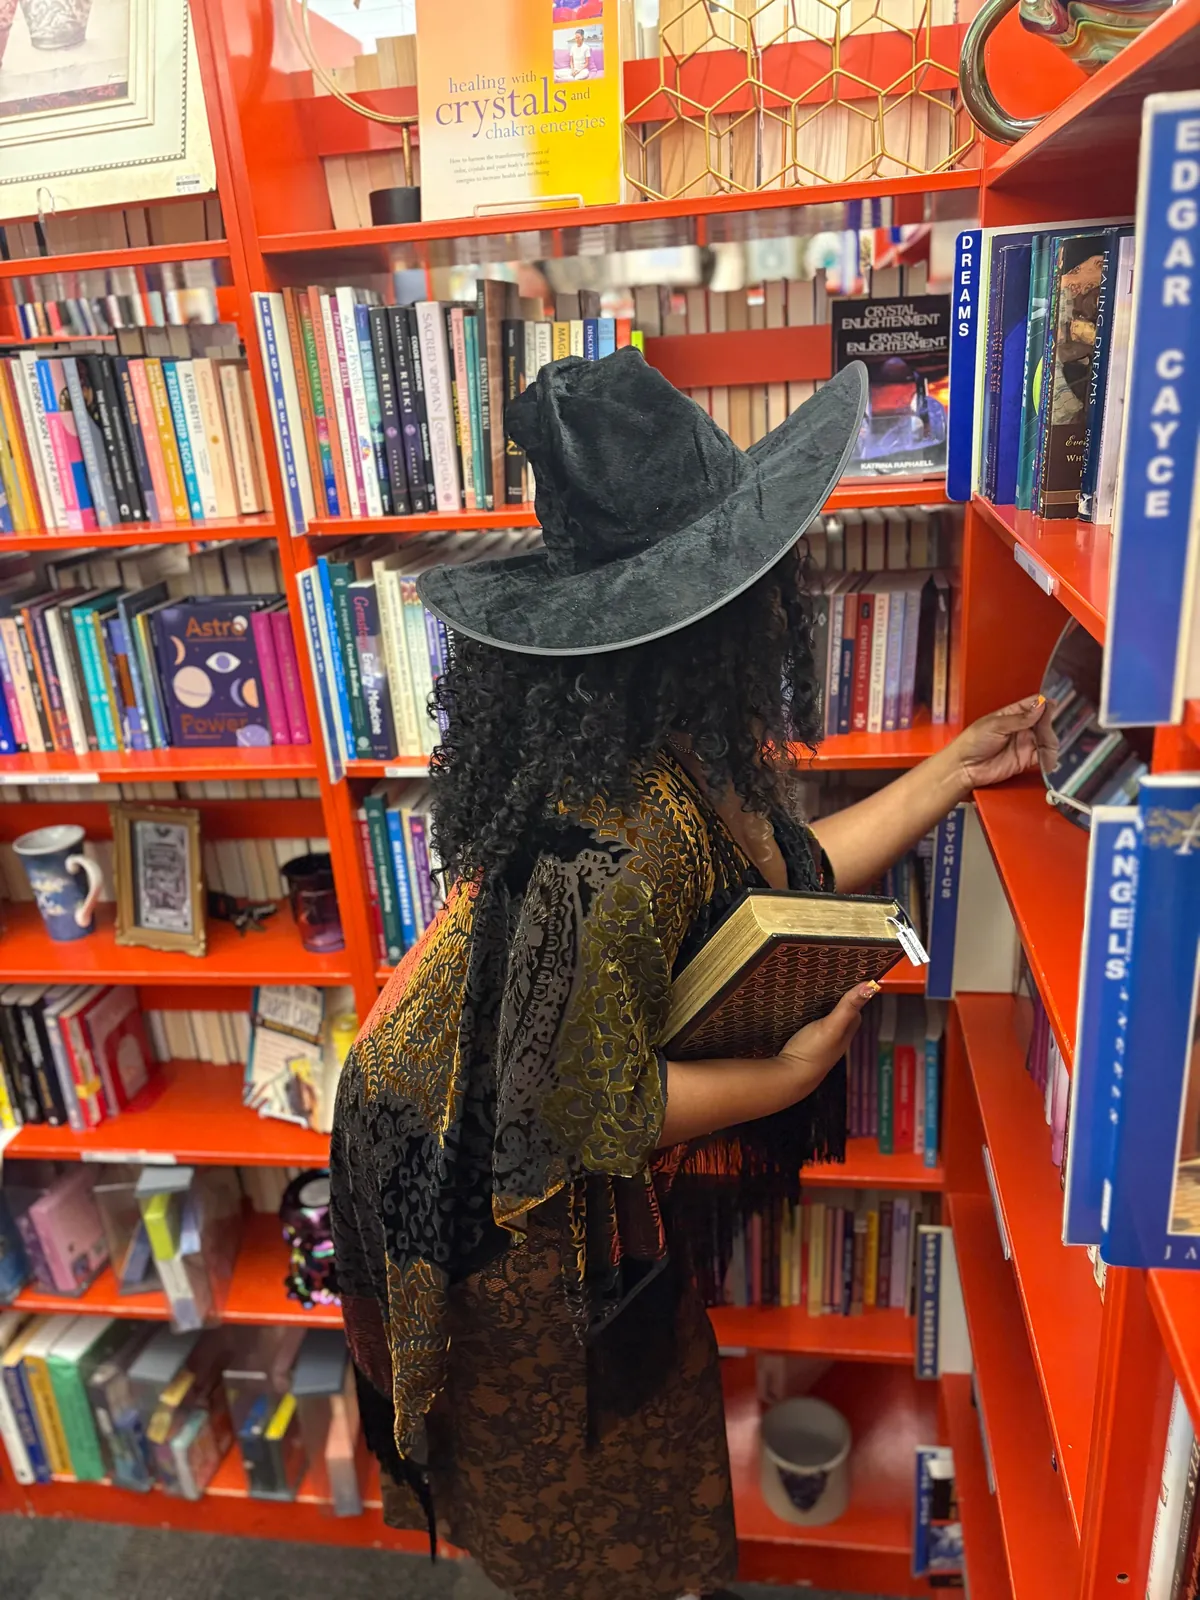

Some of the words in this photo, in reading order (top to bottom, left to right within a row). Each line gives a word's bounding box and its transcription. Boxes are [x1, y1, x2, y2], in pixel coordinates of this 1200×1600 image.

[449, 74, 507, 95] healing
[512, 70, 537, 84] with
[436, 76, 568, 138] crystals
[571, 87, 591, 102] and
[485, 119, 535, 140] chakra
[540, 113, 606, 137] energies
[1163, 119, 1200, 306] EDGAR
[957, 235, 974, 338] DREAMS
[1096, 249, 1110, 328] HEALING
[842, 313, 941, 330] ENLIGHTENMENT
[864, 303, 918, 318] CRYSTAL
[304, 318, 316, 359] HEALING
[333, 323, 343, 349] Power
[339, 361, 349, 389] REIKI
[410, 335, 419, 360] COLOR
[422, 311, 437, 362] SACRED
[846, 336, 947, 352] ENLIGHTENMENT
[869, 331, 923, 344] CRYSTAL
[309, 359, 321, 390] POWER
[344, 325, 356, 343] Art
[354, 397, 367, 426] Reiki
[393, 315, 403, 351] MAGICK
[399, 370, 412, 413] REIKI
[413, 360, 423, 392] MEDICINE
[1088, 336, 1102, 406] DREAMS
[262, 300, 281, 384] ENERGY
[277, 397, 297, 489] HEALING
[314, 392, 322, 403] OF
[380, 372, 393, 416] REIKI
[428, 365, 443, 412] WOMAN
[38, 415, 50, 440] SIGN
[166, 369, 187, 440] FRIENDSHIP
[179, 441, 193, 475] SIGNS
[482, 407, 490, 430] REIKI
[1144, 349, 1186, 519] CAYCE
[860, 462, 893, 470] KATRINA
[893, 459, 934, 469] RAPHAELL
[185, 615, 248, 638] Astro
[354, 594, 374, 651] Gemstone
[876, 598, 886, 640] CRYSTAL
[359, 651, 377, 689] Energy
[857, 624, 868, 680] GEMSTONES
[873, 642, 883, 686] THERAPY
[180, 712, 248, 734] Power
[366, 689, 384, 736] Medicine
[941, 811, 957, 898] PSYCHICS
[1104, 827, 1137, 980] ANGELS
